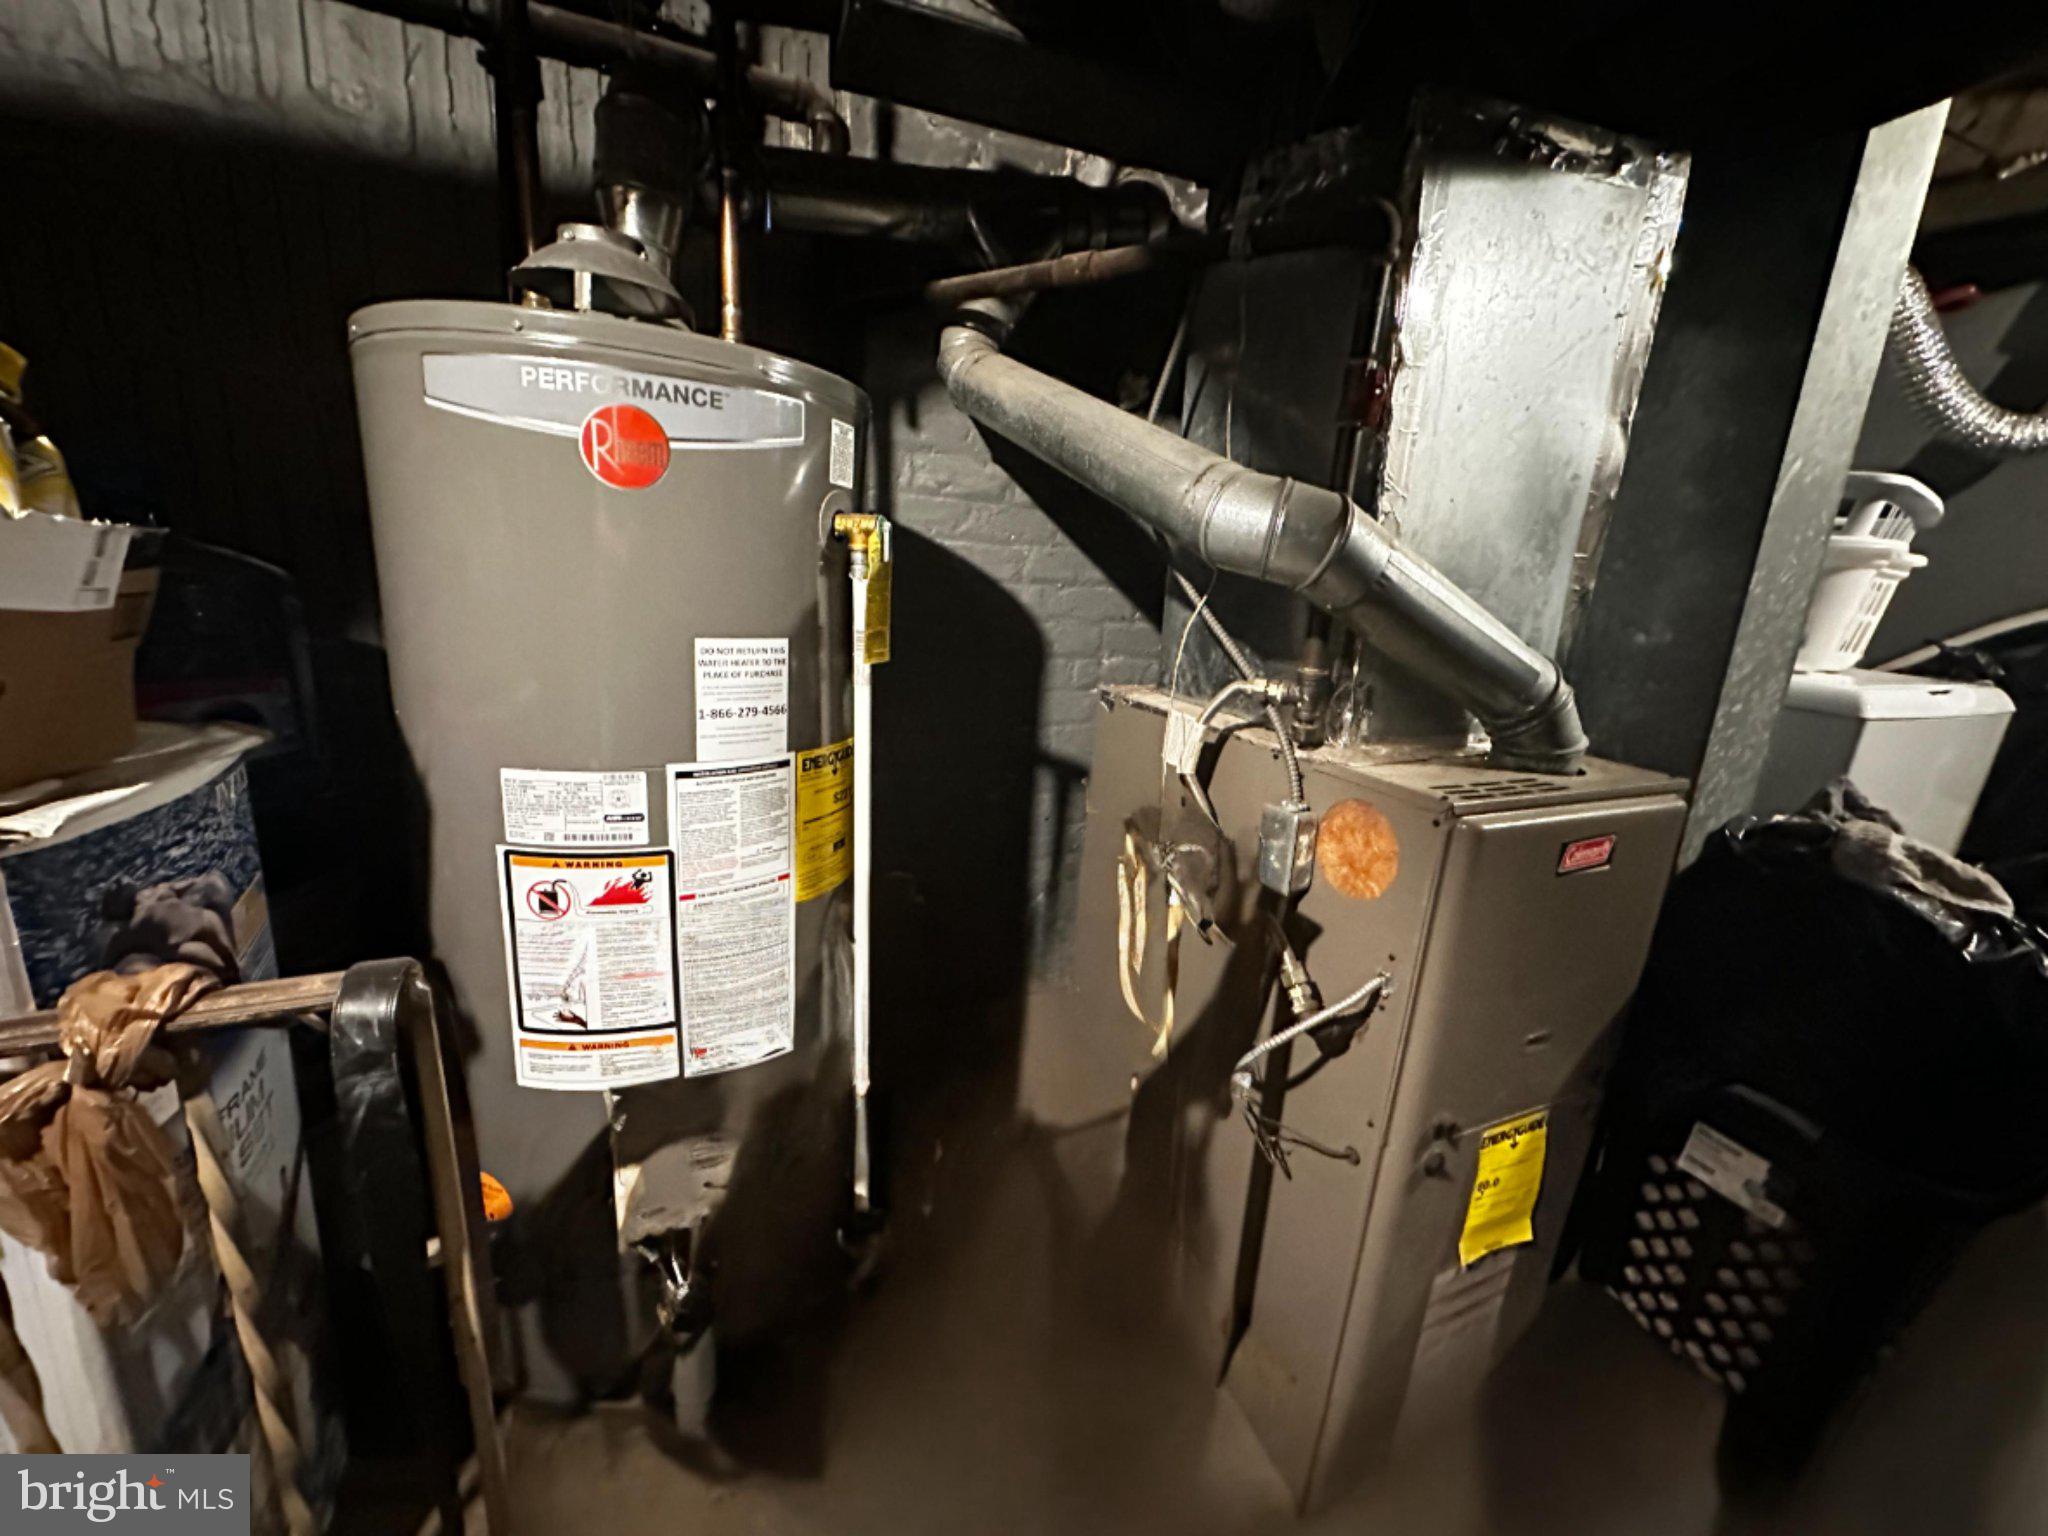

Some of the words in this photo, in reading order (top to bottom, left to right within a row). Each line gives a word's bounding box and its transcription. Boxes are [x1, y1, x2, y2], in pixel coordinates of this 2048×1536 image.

[520, 365, 723, 410] PERFORMANCE
[716, 647, 734, 655] NOT
[565, 861, 623, 869] WARNING
[582, 1040, 630, 1050] WARNING
